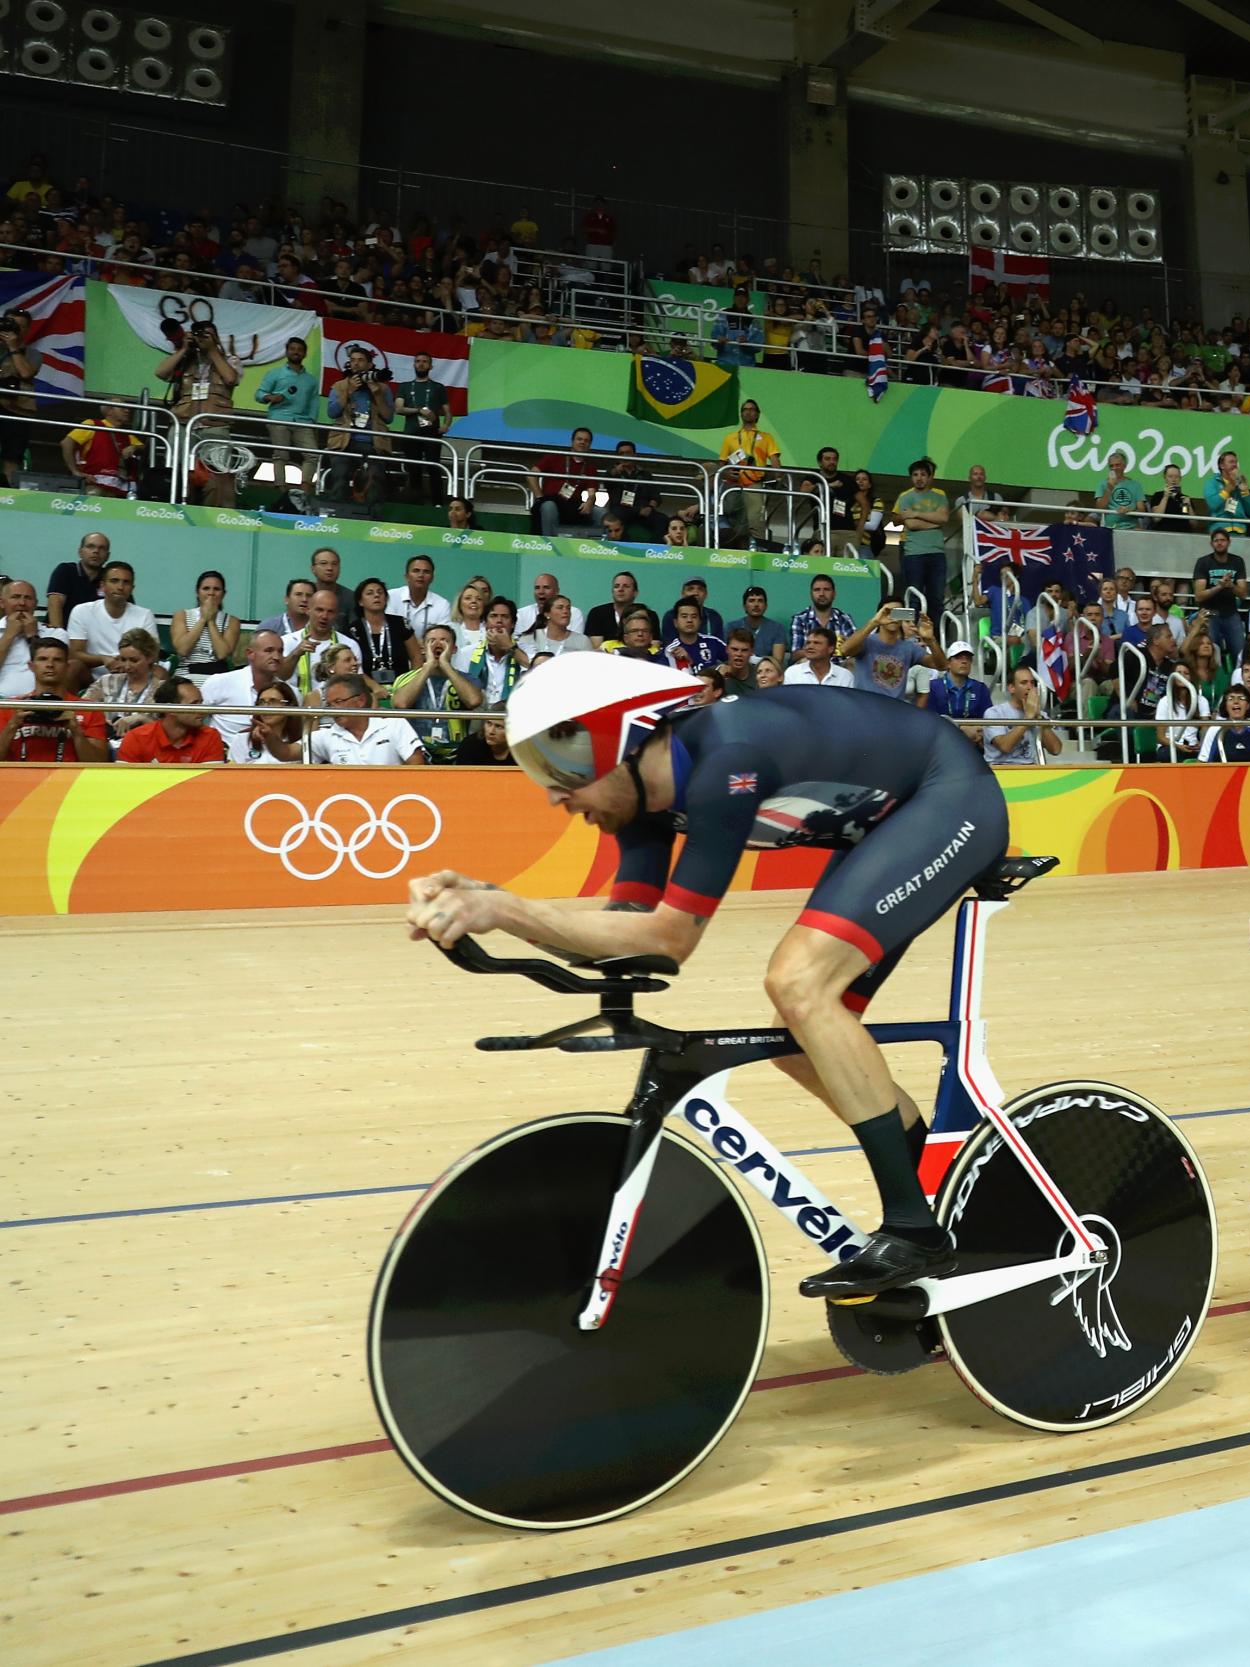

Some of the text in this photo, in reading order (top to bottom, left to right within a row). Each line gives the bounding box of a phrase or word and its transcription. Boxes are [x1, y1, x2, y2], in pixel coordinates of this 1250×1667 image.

[875, 820, 976, 915] GREAT BRITAIN
[717, 1035, 785, 1046] GREAT BRITAIN
[1074, 1314, 1192, 1419] GHIBLI
